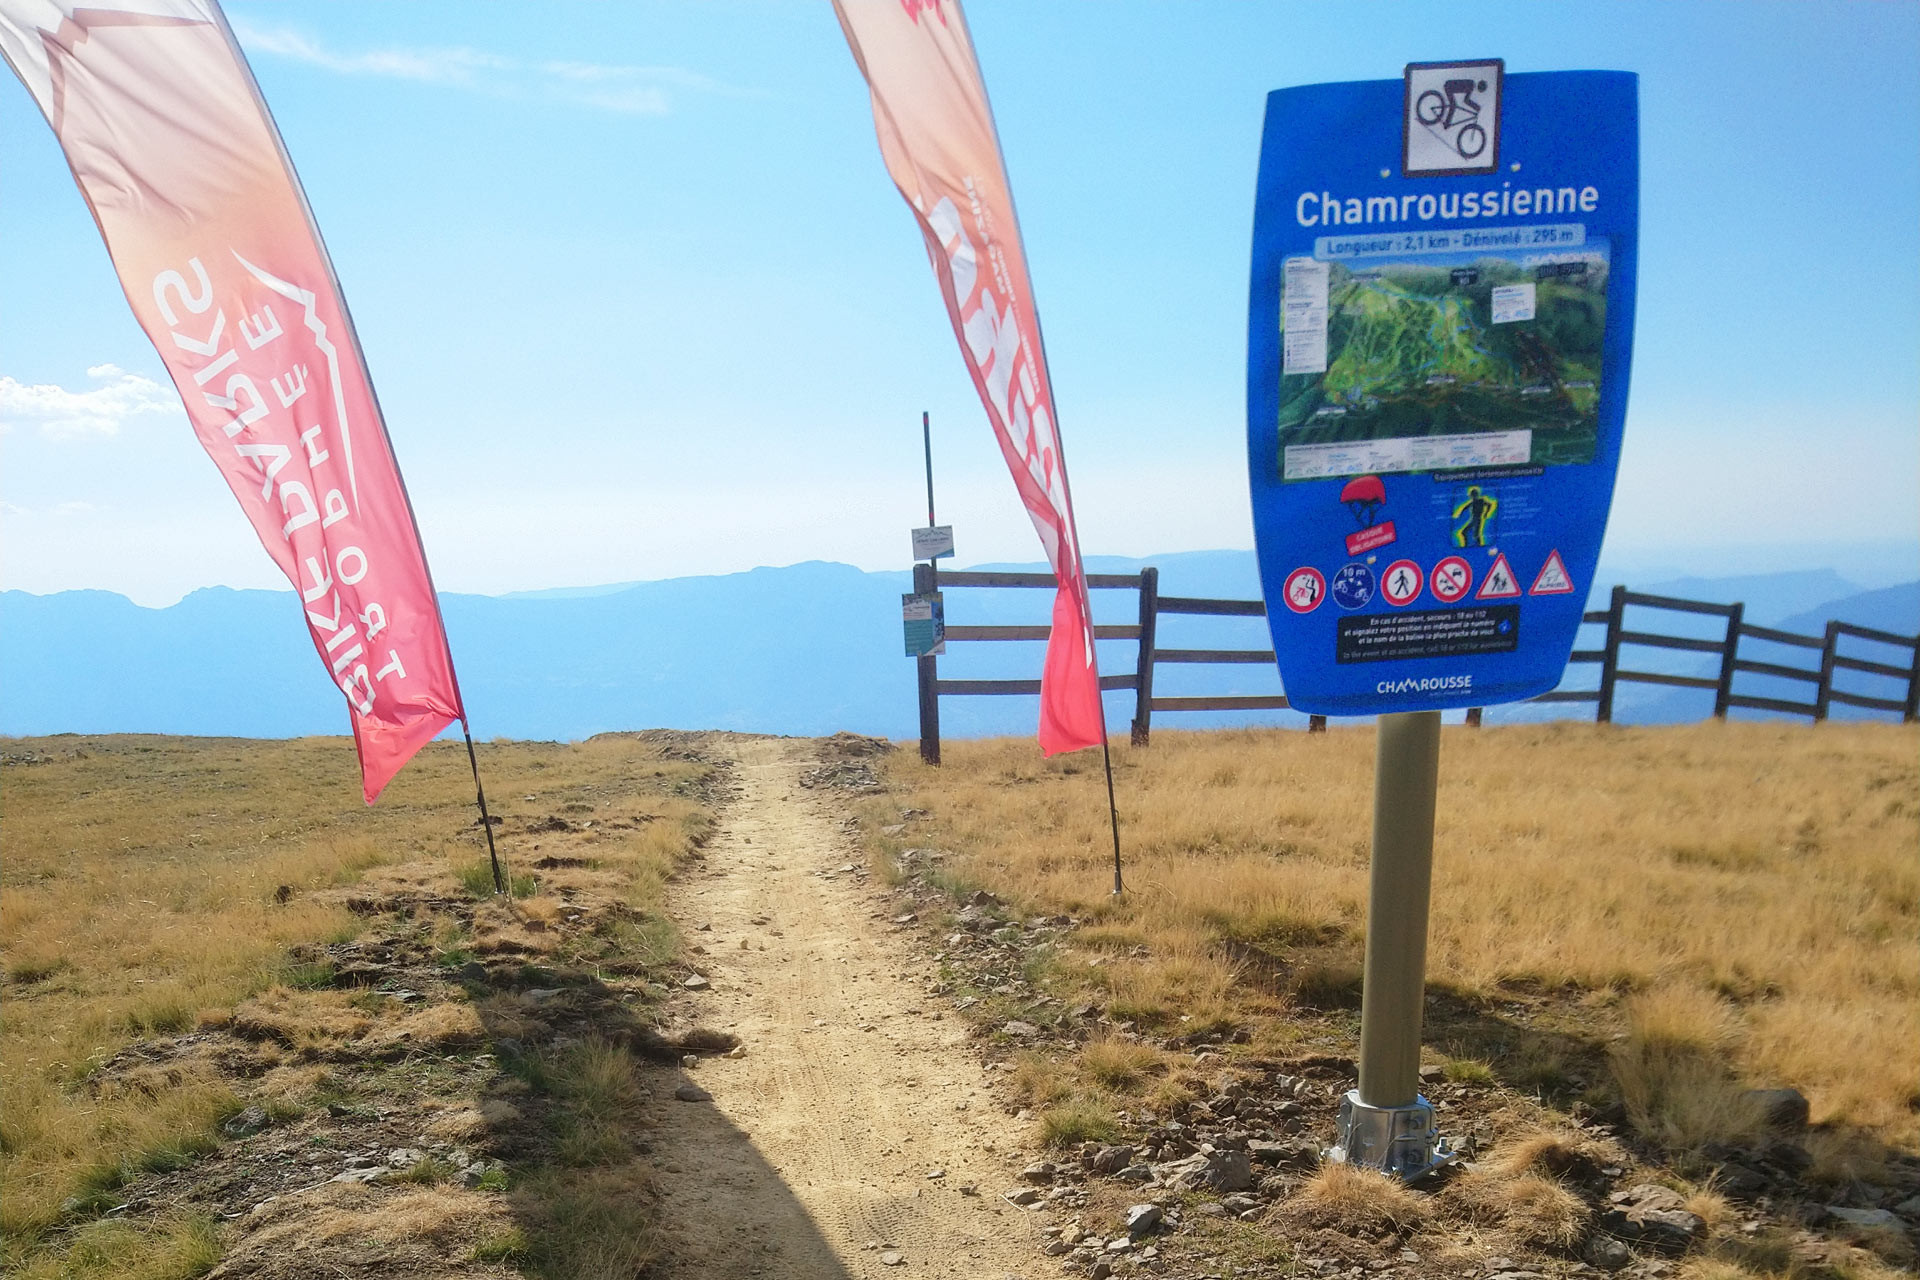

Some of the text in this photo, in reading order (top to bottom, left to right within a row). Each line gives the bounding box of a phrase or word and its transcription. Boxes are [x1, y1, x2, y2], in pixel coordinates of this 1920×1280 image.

[1296, 181, 1599, 228] Chamroussienne
[1327, 237, 1392, 257] Longueur
[1404, 234, 1423, 250] 2,1
[1428, 233, 1449, 247] km
[1462, 228, 1519, 245] Dénivelé
[1533, 228, 1556, 242] 295
[1559, 230, 1572, 241] m
[1377, 675, 1472, 693] CHAMROUSSE
